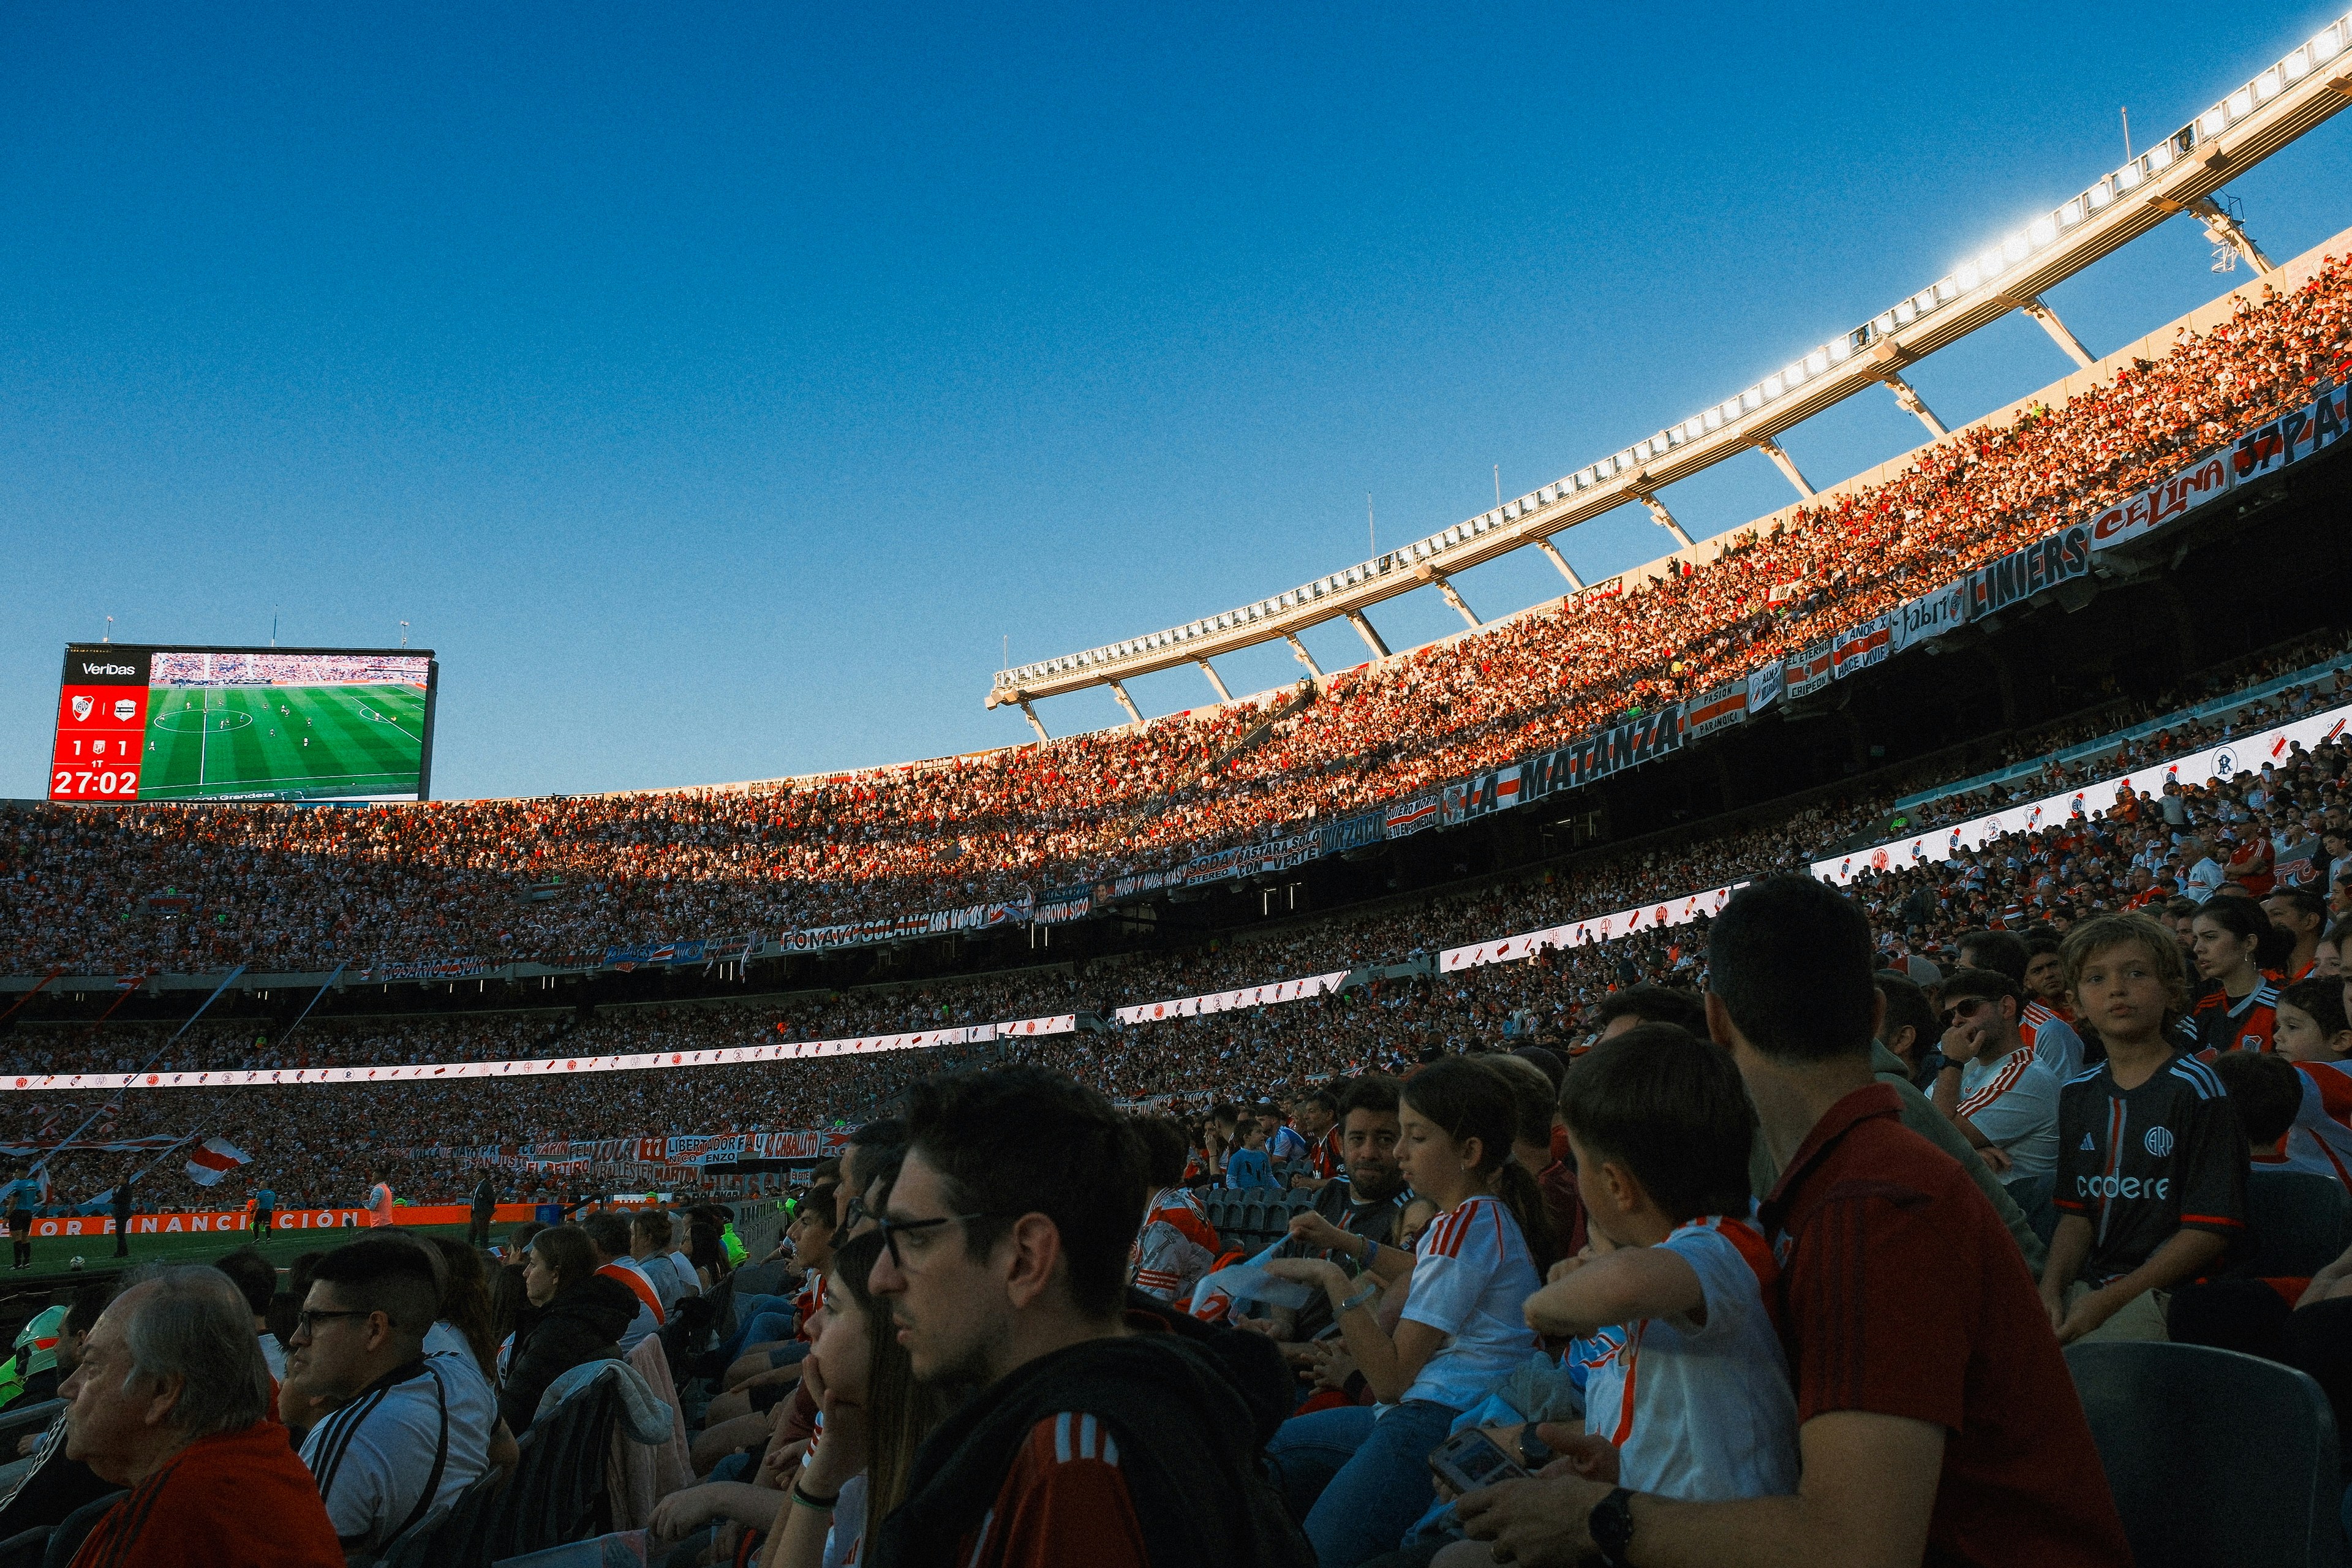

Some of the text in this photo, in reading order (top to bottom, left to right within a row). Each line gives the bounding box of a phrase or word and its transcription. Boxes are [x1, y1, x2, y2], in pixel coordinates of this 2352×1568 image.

[1969, 527, 2085, 620] LINIERS
[1837, 617, 1887, 649] EL AMOR X
[1787, 654, 1797, 665] EL
[1838, 657, 1860, 678] HACE
[1704, 685, 1733, 705] PASION
[1699, 712, 1738, 734] PARANOICA
[73, 740, 126, 756] 1 1
[1464, 707, 1679, 821] LA MATANZA
[54, 771, 136, 794] 27:02
[1387, 804, 1414, 820] QUIERO
[1238, 828, 1321, 864] BASTARA SOLO
[1321, 813, 1383, 854] BURZACO
[1188, 851, 1230, 876] SODA
[1238, 845, 1317, 877] CON VERTE
[1115, 877, 1135, 897] HUGO
[1136, 876, 1142, 892] Y
[1143, 872, 1163, 891] NADA
[1189, 869, 1229, 884] STEREO
[930, 910, 949, 933] LOS
[950, 904, 986, 929] VAGOS
[1035, 901, 1068, 925] ARROYO
[1069, 895, 1088, 921] SECO
[861, 913, 929, 943] SOLANO
[644, 1138, 662, 1157] 77
[668, 1136, 736, 1153] LIBERTADOR
[775, 1132, 818, 1158] CABALLITO
[546, 1159, 589, 1174] RETIRO
[668, 1152, 736, 1164] NICO ENZO
[655, 1169, 698, 1186] MARTIN
[2076, 1166, 2170, 1200] codere
[103, 1210, 358, 1235] FINANCICIÓN
